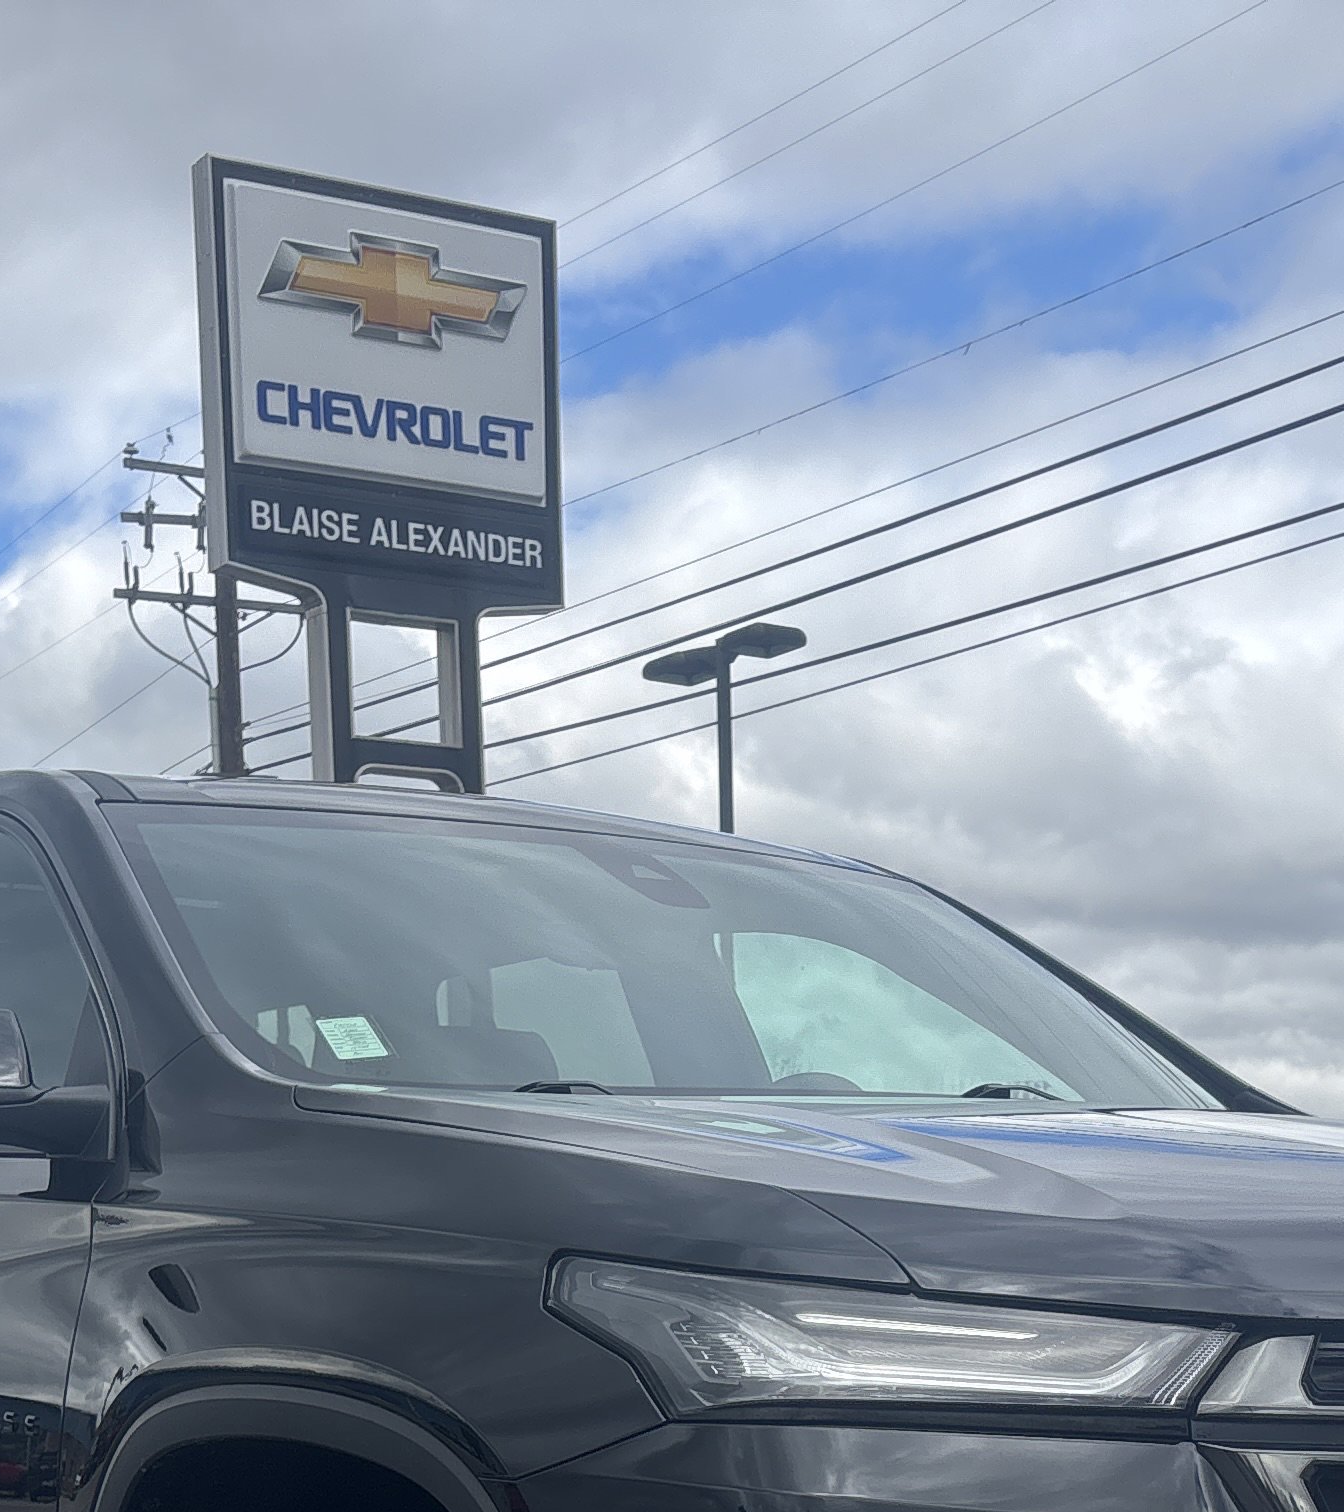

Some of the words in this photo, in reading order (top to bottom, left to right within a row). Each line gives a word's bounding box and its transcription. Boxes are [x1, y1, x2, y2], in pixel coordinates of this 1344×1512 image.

[256, 380, 533, 461] CHEVROLET
[251, 500, 360, 543] BLAISE
[370, 518, 542, 568] ALEXANDER
